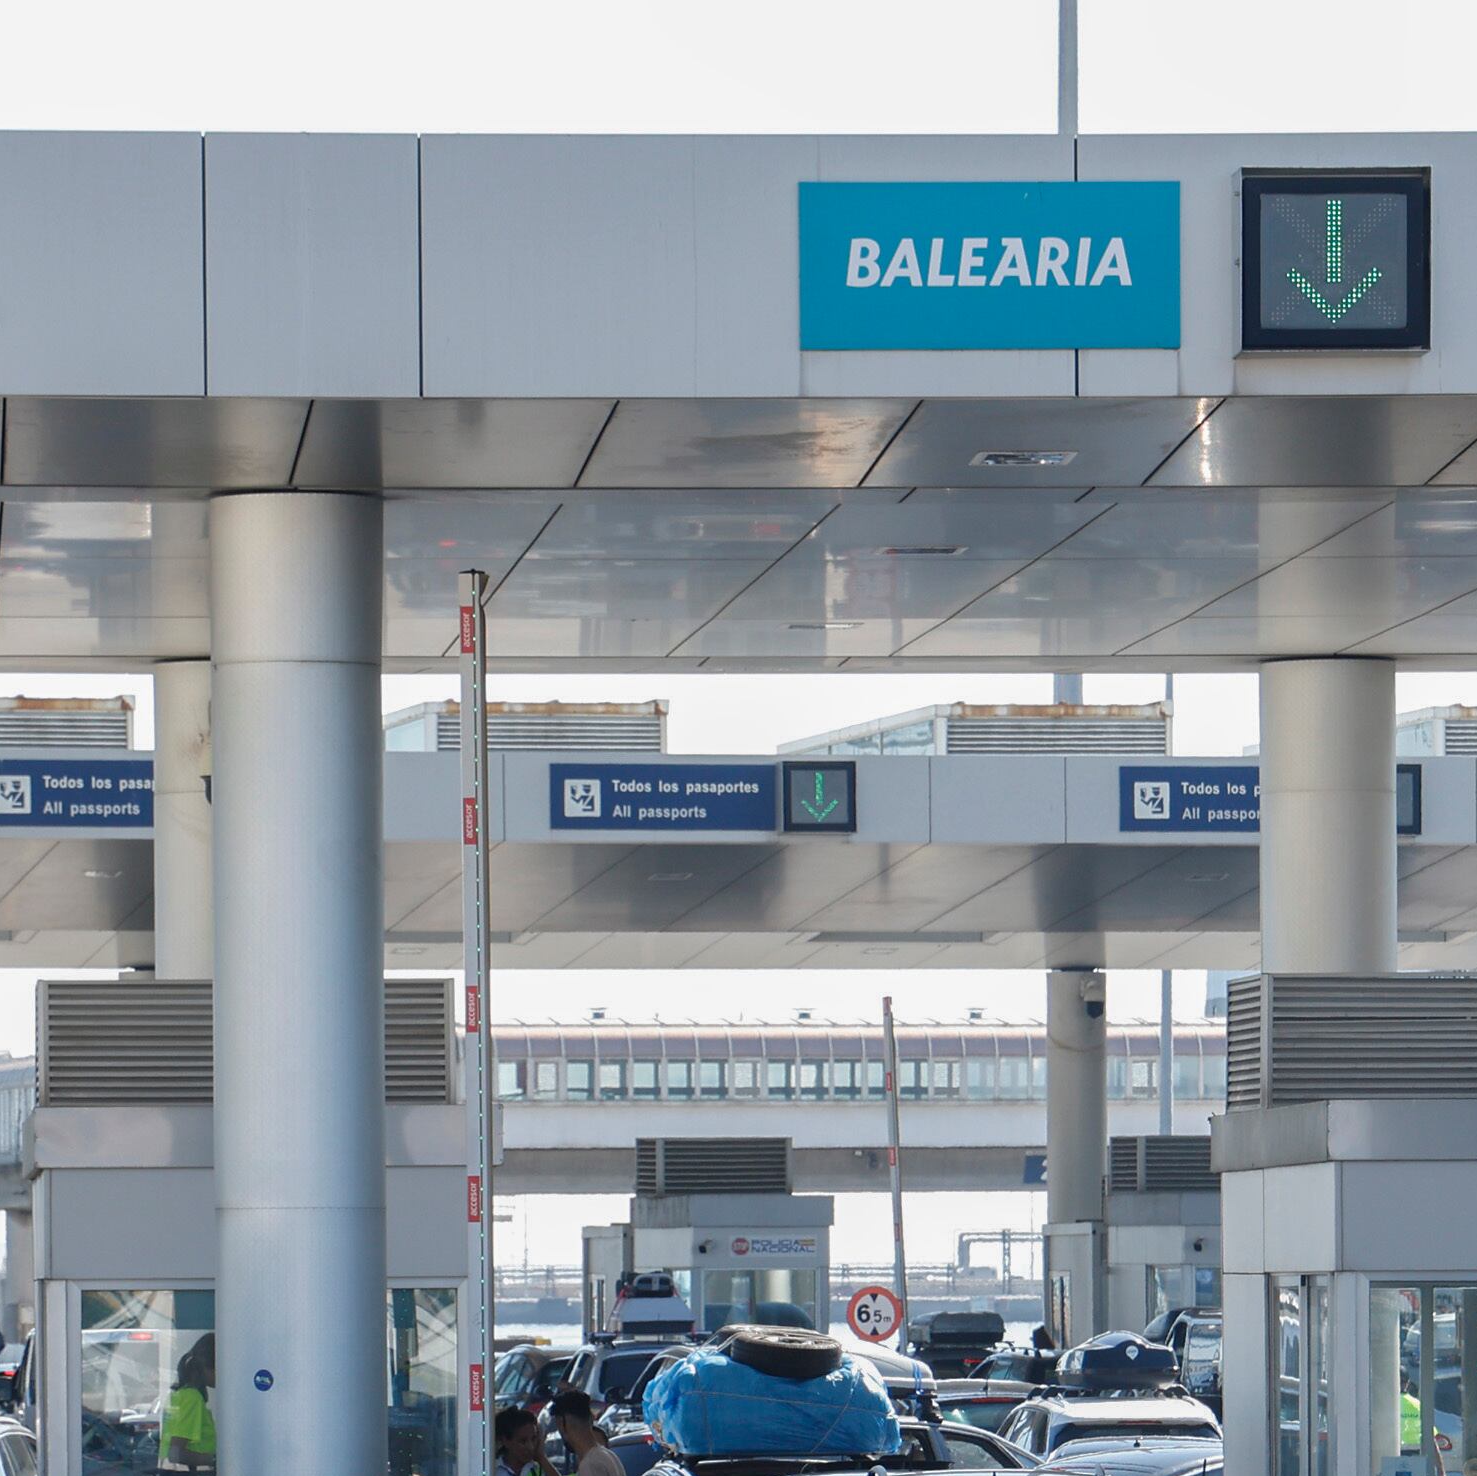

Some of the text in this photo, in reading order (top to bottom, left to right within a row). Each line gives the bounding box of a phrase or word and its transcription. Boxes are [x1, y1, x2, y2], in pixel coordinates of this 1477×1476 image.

[42, 775, 84, 789] Todos
[91, 776, 113, 789] los
[612, 779, 759, 796] Todos los pasaportes
[1181, 782, 1220, 795] Todos
[1227, 782, 1247, 795] los
[43, 801, 141, 818] All passports
[613, 805, 707, 821] All passports
[1182, 808, 1200, 820] All
